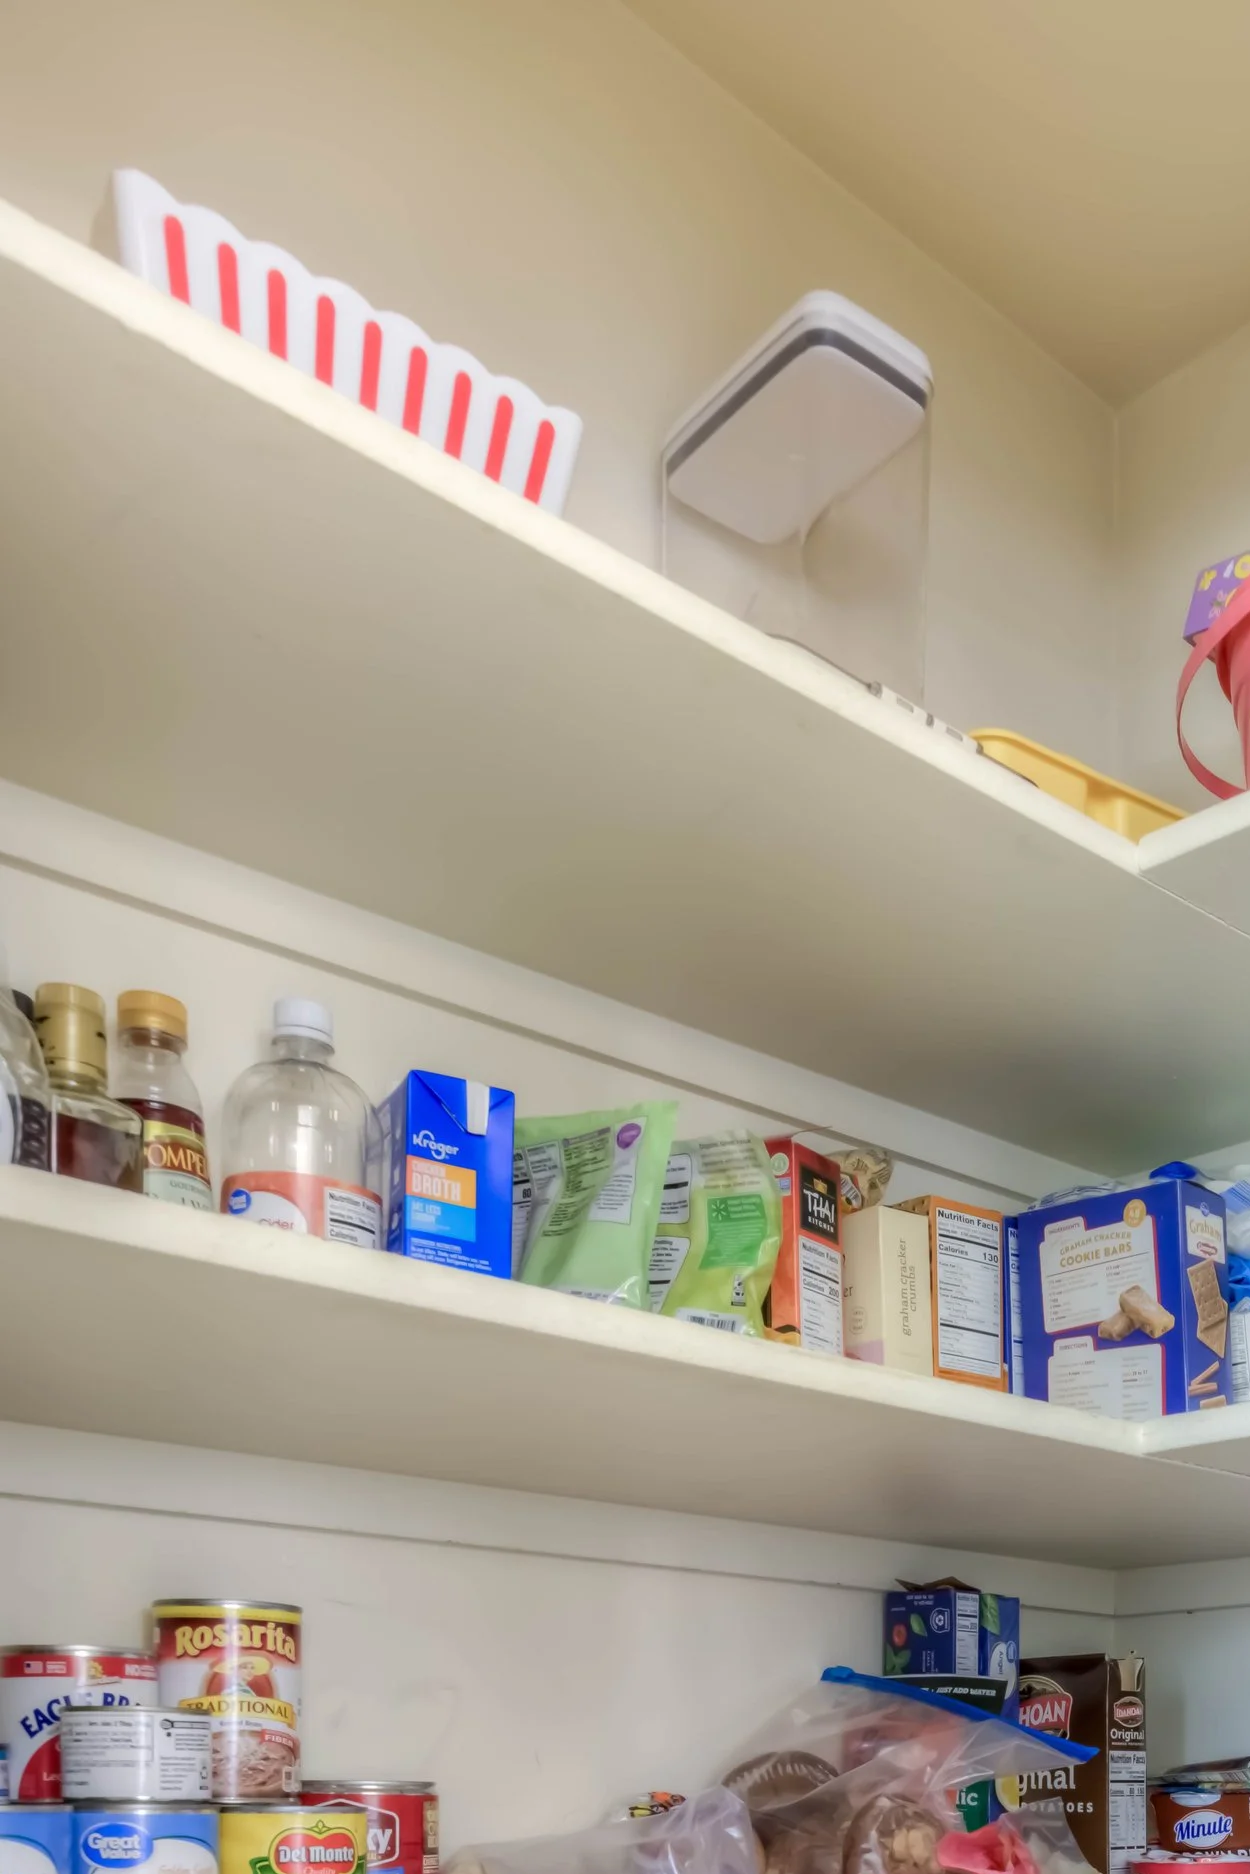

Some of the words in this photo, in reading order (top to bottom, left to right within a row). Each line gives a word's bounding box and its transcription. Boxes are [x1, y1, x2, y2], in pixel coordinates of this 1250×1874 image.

[412, 1130, 460, 1160] Kroger
[803, 1188, 835, 1223] THAI
[808, 1216, 834, 1233] KITCHEN
[937, 1209, 975, 1226] Nutrition
[977, 1218, 999, 1233] Facts
[1188, 1218, 1222, 1242] Graham
[938, 1243, 969, 1257] Calories
[982, 1252, 999, 1264] 130
[1059, 1238, 1092, 1255] GRAHAM
[1059, 1250, 1101, 1268] COOKIE
[1103, 1241, 1132, 1258] BARS
[897, 1238, 907, 1287] cracker
[909, 1265, 917, 1313] crumbs
[901, 1289, 912, 1337] graham
[175, 1621, 296, 1662] Rosarita
[952, 1687, 969, 1695] ADD
[969, 1688, 997, 1697] WATER
[187, 1697, 290, 1721] TRADITIONAL
[1018, 1700, 1067, 1728] HOAN
[264, 1733, 294, 1749] FIBER
[1110, 1728, 1145, 1743] Original
[1110, 1754, 1131, 1764] Nutrition
[1015, 1766, 1076, 1792] ginal
[1173, 1816, 1233, 1843] Minute
[88, 1833, 141, 1851] Great
[278, 1845, 307, 1863] Del
[309, 1845, 354, 1863] Monte
